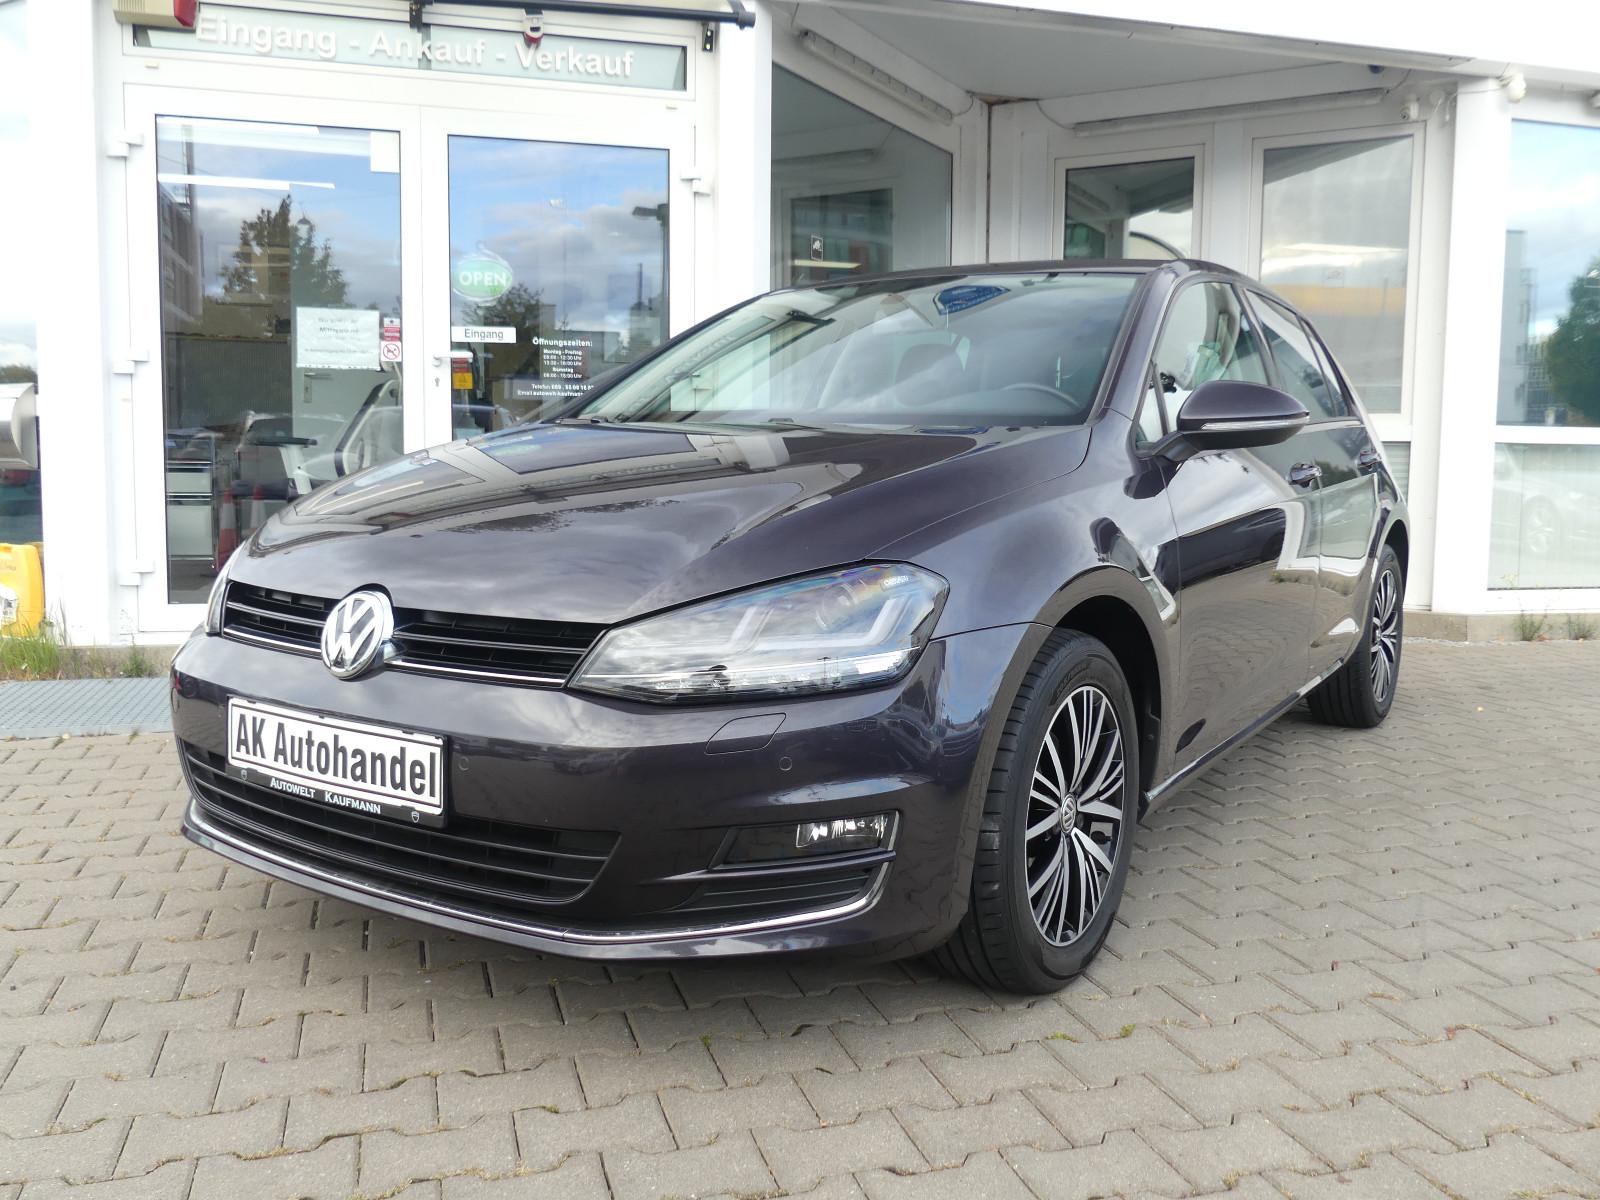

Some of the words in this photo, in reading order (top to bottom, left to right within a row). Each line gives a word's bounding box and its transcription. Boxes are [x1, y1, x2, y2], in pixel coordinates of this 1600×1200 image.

[197, 14, 337, 58] Eingang
[369, 29, 486, 65] Ankauf
[514, 39, 635, 77] Verkauf
[458, 271, 508, 288] OPEN
[464, 328, 504, 341] Eingang
[532, 336, 593, 348] Öffnungszeiten:
[235, 713, 267, 760] AK
[273, 721, 437, 798] Autohandel
[269, 777, 316, 799] AUTOWELT
[324, 791, 382, 815] KAUFMANN
